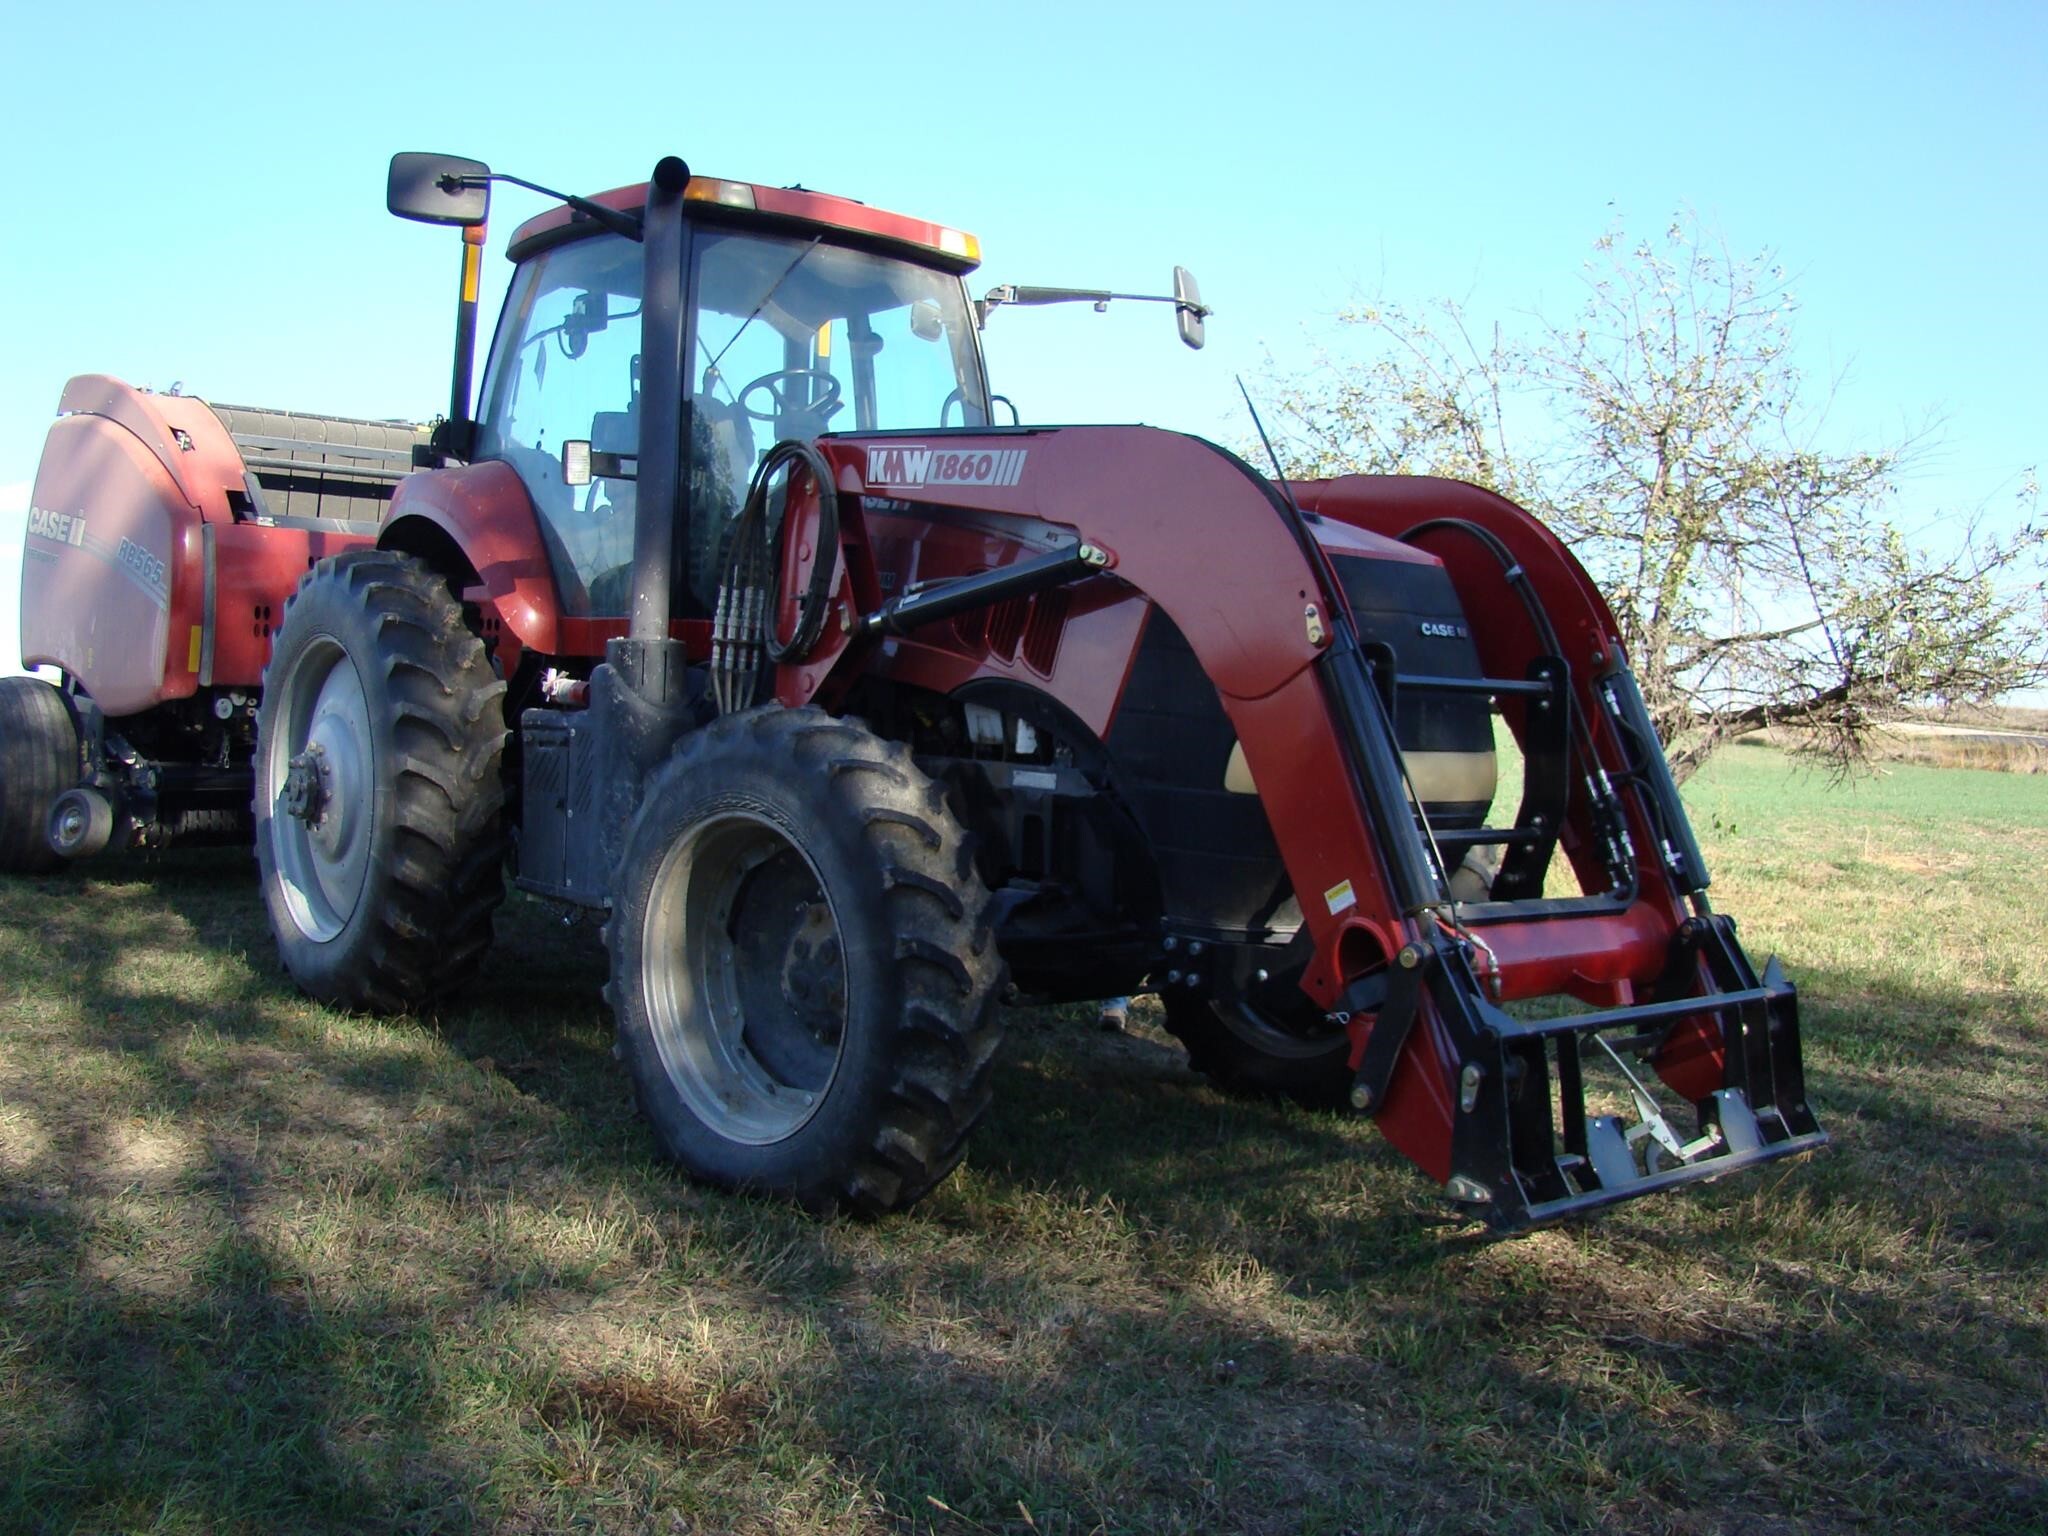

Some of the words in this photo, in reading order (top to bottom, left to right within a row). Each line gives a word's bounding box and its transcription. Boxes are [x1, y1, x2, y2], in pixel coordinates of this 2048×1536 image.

[868, 450, 932, 483] KMW
[933, 454, 993, 481] 1860
[28, 506, 71, 542] CASE
[118, 535, 166, 585] RB565
[1421, 622, 1456, 637] CASE
